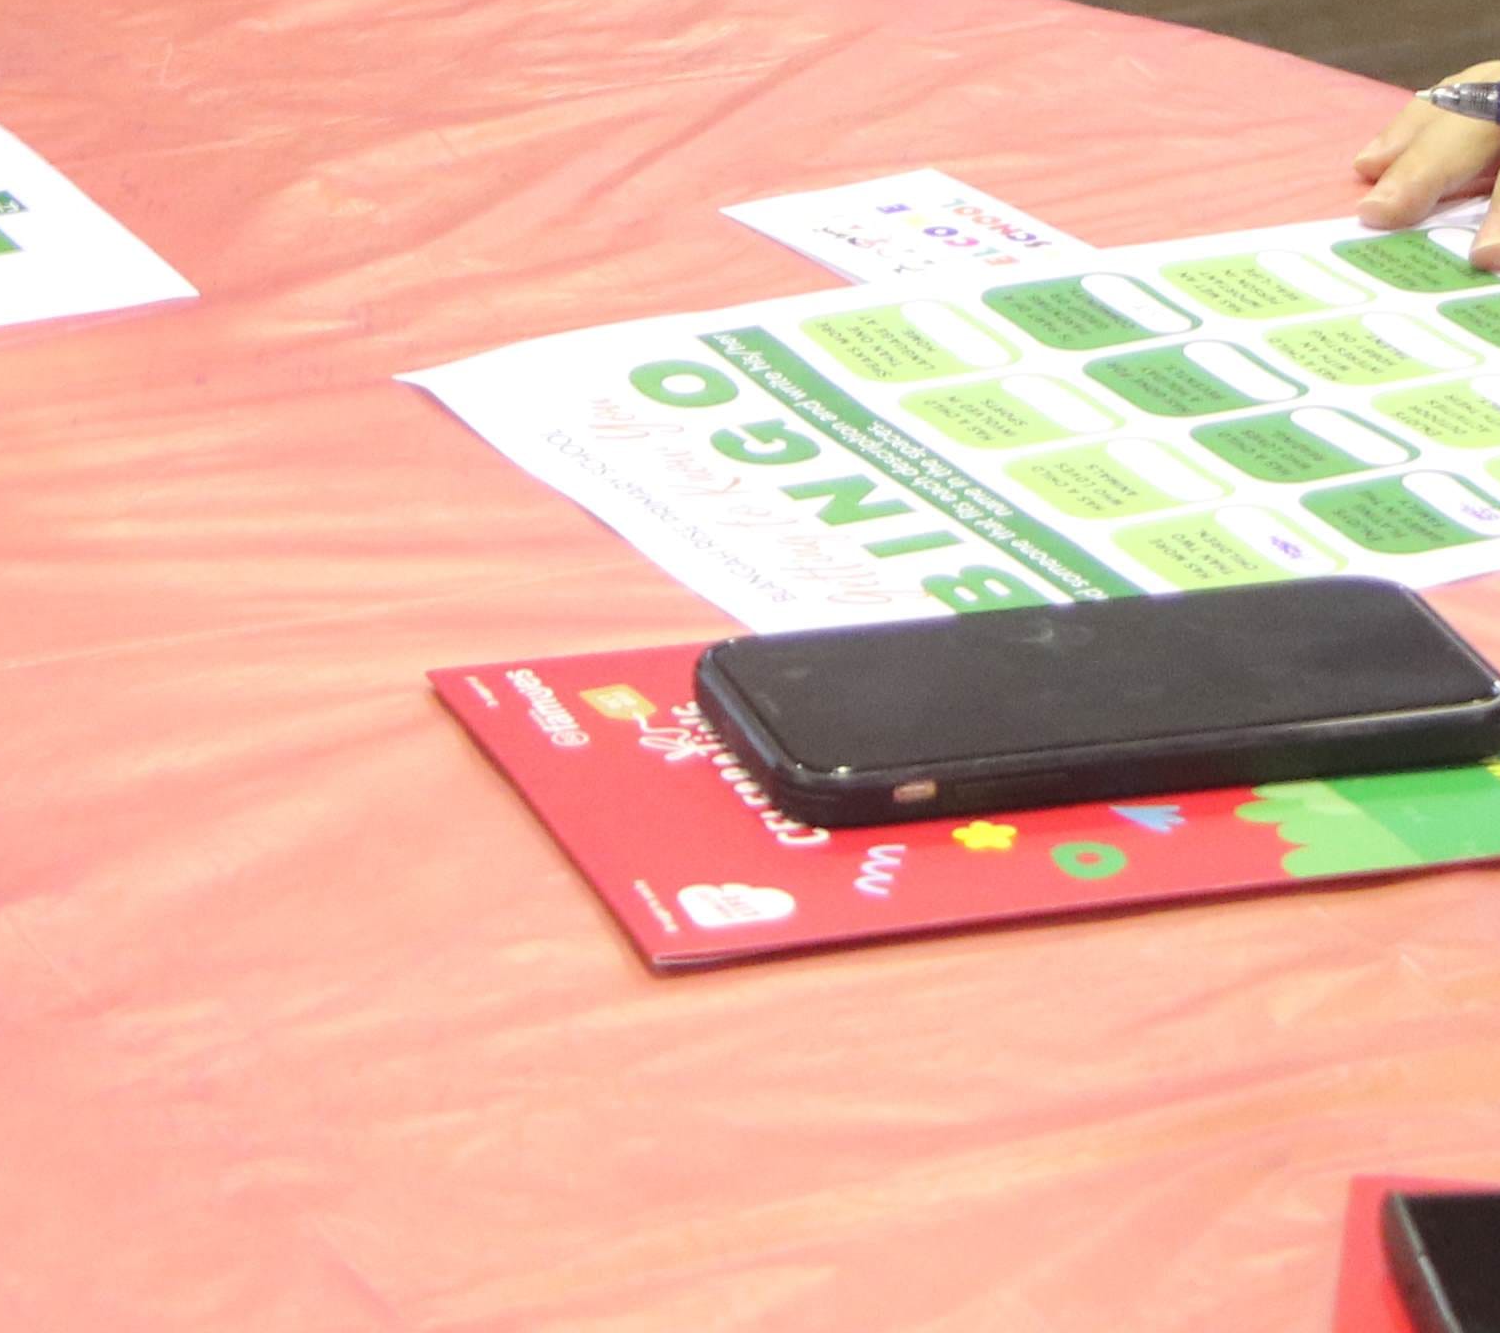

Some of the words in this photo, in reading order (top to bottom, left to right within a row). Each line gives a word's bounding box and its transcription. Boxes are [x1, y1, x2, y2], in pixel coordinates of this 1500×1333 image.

[821, 323, 850, 345] MORE
[859, 317, 878, 325] AT
[848, 327, 874, 343] ONE
[711, 333, 781, 373] his/her
[847, 347, 892, 377] SPEAKS
[874, 345, 898, 367] THAN
[876, 329, 934, 369] LANGUAGE
[751, 370, 814, 400] write
[591, 396, 650, 441] You
[789, 399, 844, 424] and
[544, 430, 619, 475] SCHOOL
[825, 421, 928, 478] description
[867, 420, 932, 459] spaces.
[657, 450, 742, 498] Know
[909, 457, 958, 478] the
[937, 474, 975, 488] in
[1031, 466, 1069, 487] CHILD
[1055, 463, 1096, 487] LOVES
[615, 476, 683, 521] PRIMARY
[629, 359, 1050, 616] BINGO
[905, 476, 962, 504] each
[1094, 489, 1123, 506] WHO
[941, 501, 987, 521] fits
[955, 486, 1018, 517] name
[1078, 496, 1103, 511] HAS
[727, 502, 794, 531] to
[965, 516, 1024, 541] that
[677, 523, 719, 550] RISE
[1172, 534, 1197, 552] TWO
[1001, 536, 1097, 588] someone
[1150, 539, 1186, 562] MORE
[711, 548, 799, 603] BLANGAH
[780, 531, 929, 606] Getting
[1184, 563, 1210, 579] HAS
[1202, 554, 1231, 575] THAN
